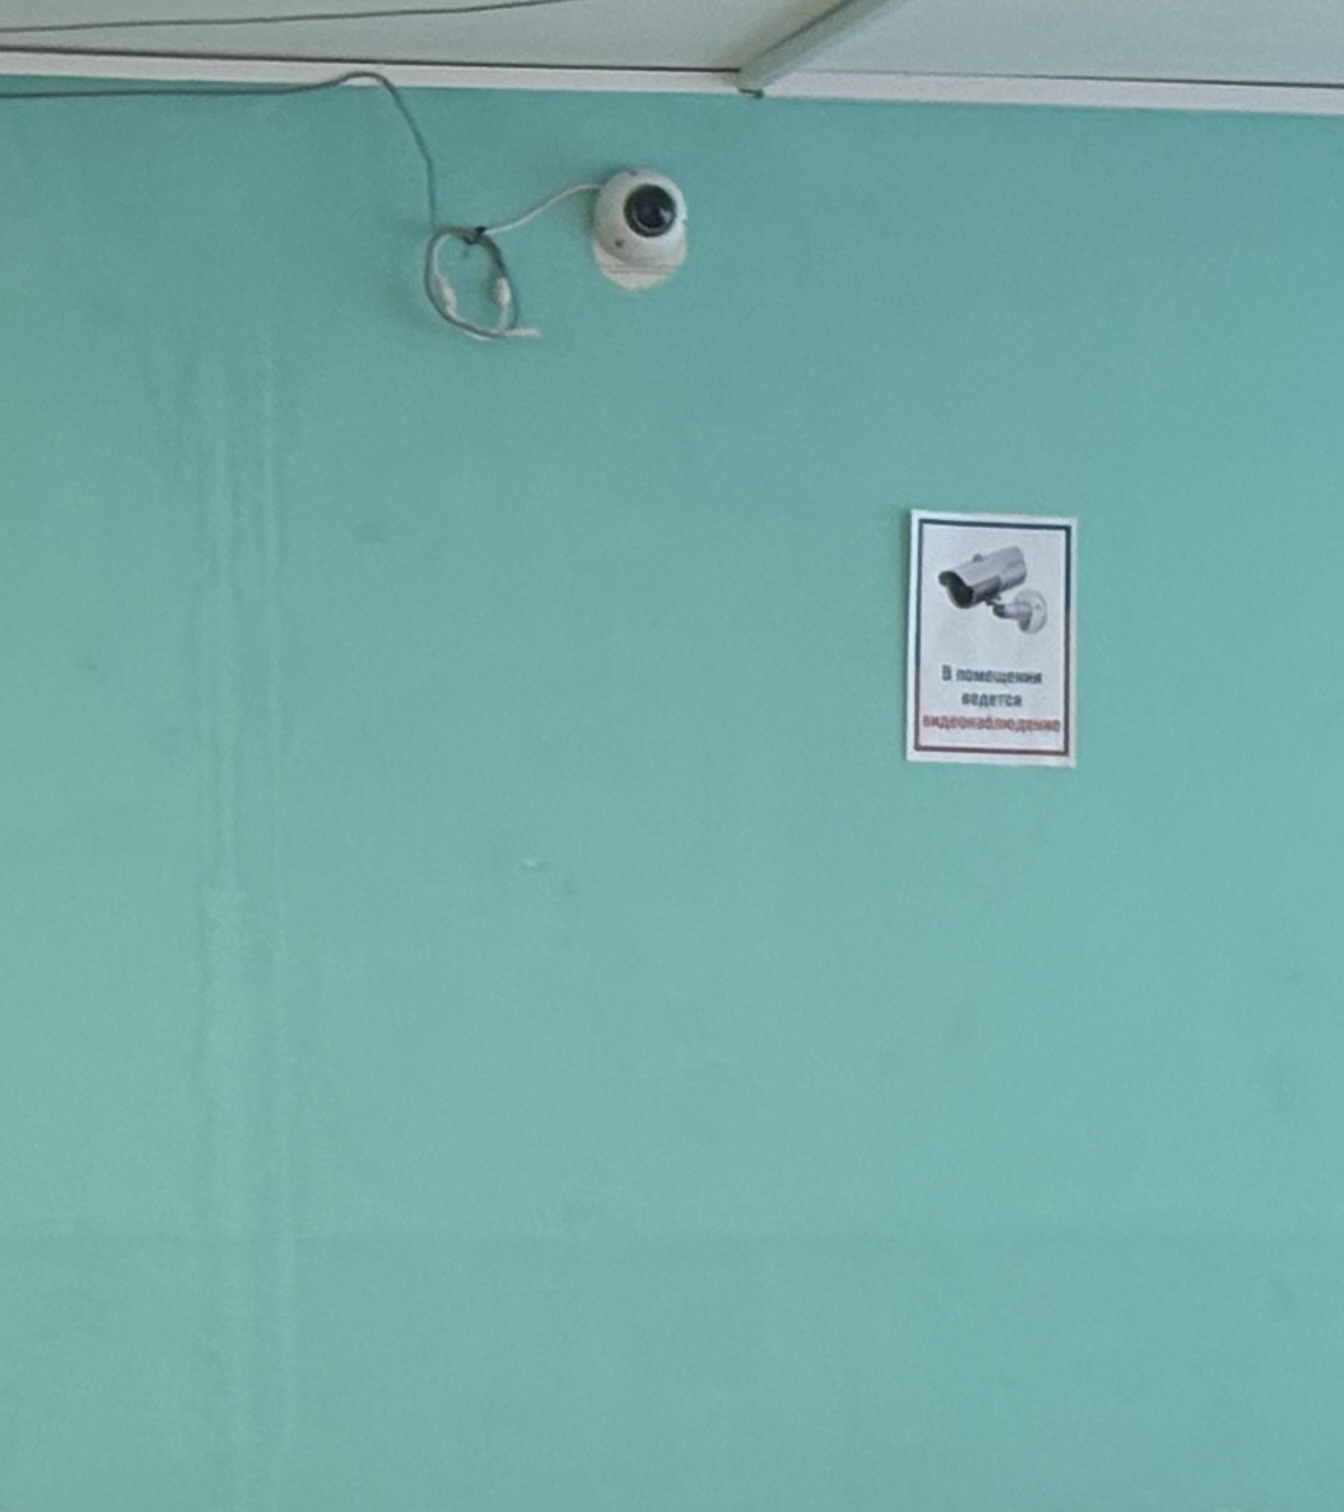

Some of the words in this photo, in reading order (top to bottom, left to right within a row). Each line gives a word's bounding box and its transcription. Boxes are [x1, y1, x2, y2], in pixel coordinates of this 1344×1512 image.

[942, 665, 953, 682] В
[962, 693, 1022, 708] ведется
[923, 715, 1061, 733] видеонаблюдение
